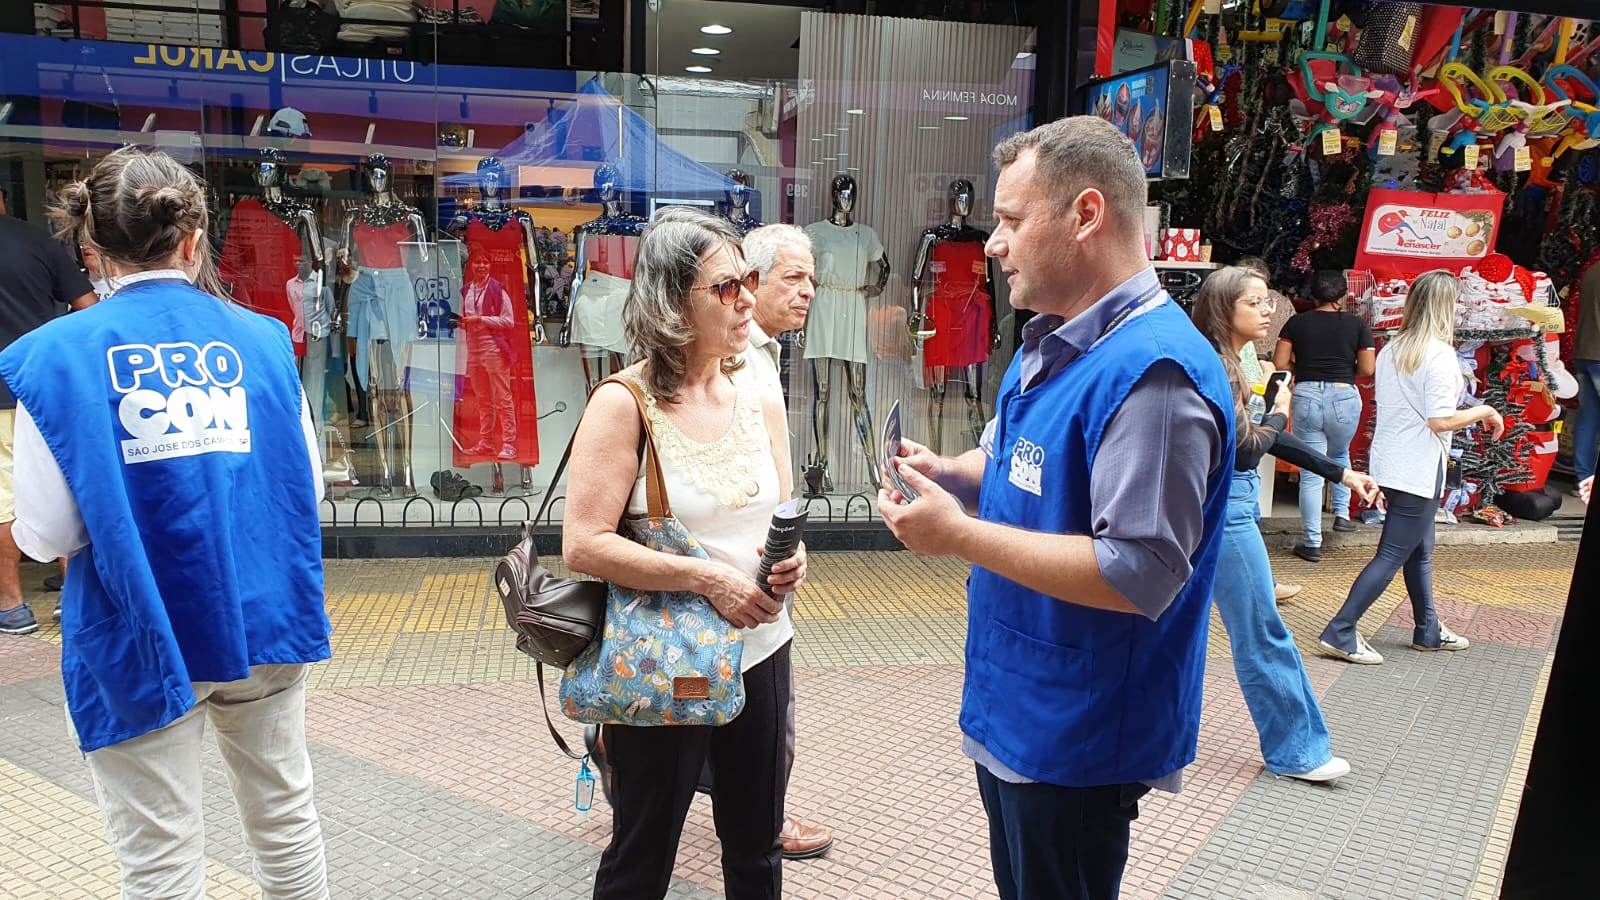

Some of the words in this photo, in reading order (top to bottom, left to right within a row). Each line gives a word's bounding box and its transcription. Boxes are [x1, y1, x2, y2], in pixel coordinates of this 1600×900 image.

[1420, 209, 1451, 218] FELIZ
[1421, 217, 1447, 231] Natal
[106, 341, 243, 394] PRO
[118, 386, 249, 439] CON
[1013, 436, 1045, 467] PRO
[1010, 455, 1042, 485] CON
